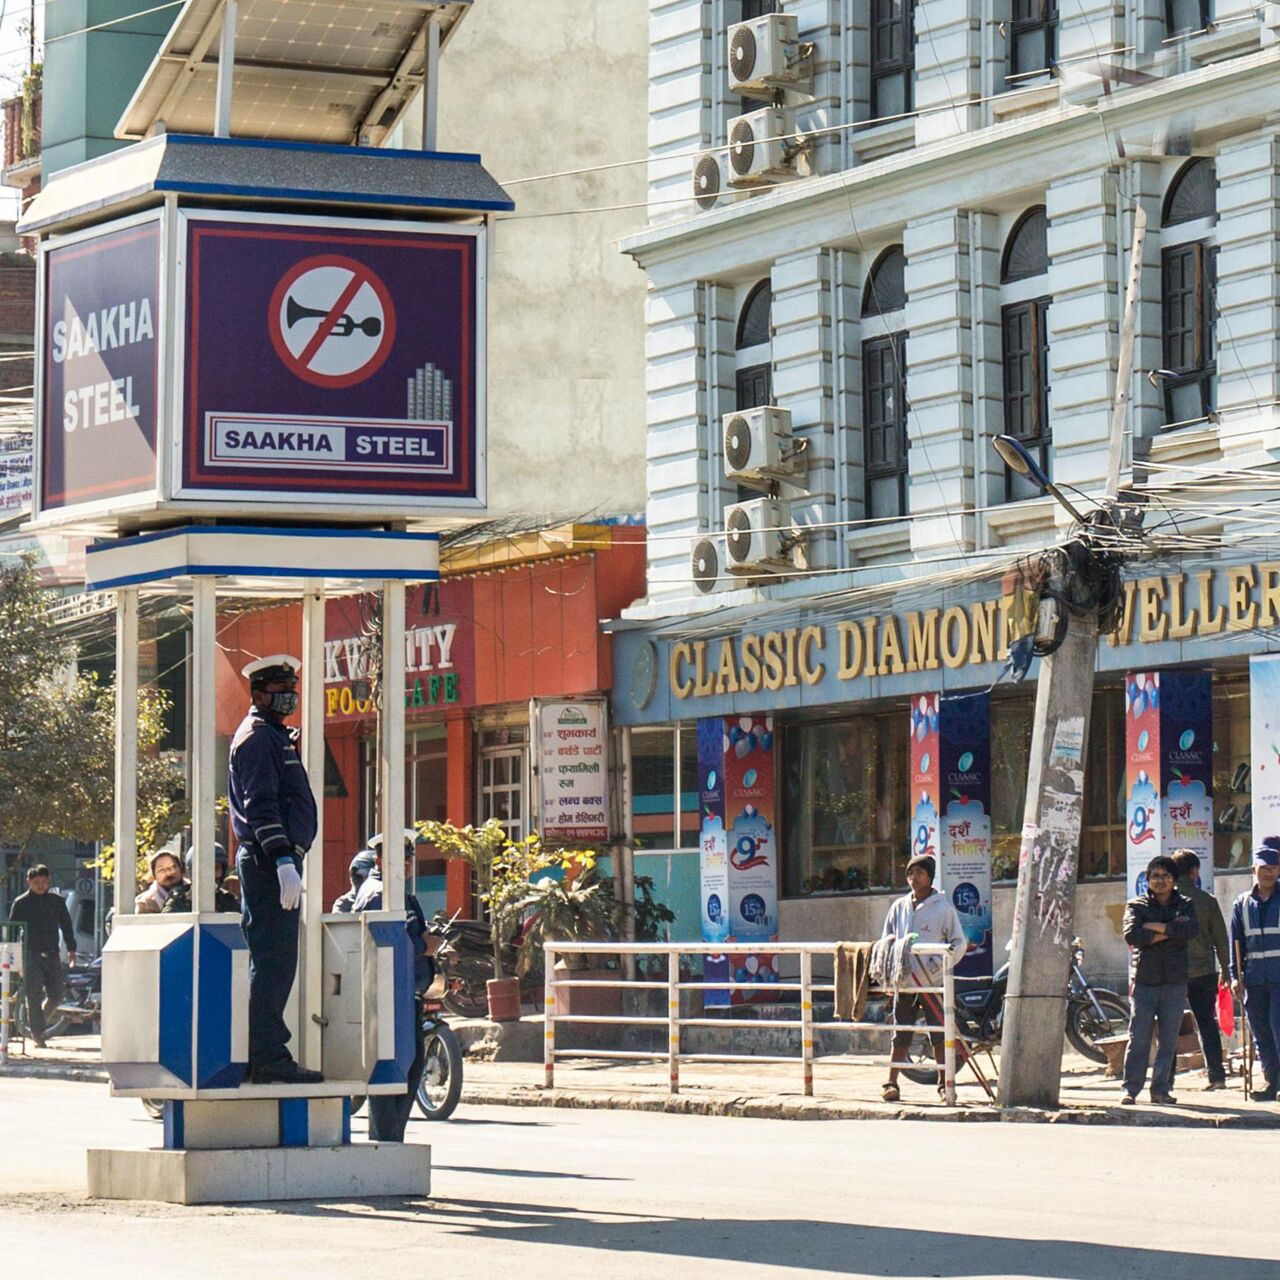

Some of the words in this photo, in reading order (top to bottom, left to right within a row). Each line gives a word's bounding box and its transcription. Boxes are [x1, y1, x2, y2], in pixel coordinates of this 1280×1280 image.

[52, 297, 154, 363] SAAKHA
[63, 375, 141, 433] STEEL
[224, 428, 333, 454] SAAKHA
[355, 434, 436, 458] STEEL
[324, 624, 457, 683] KWITY
[670, 625, 825, 700] CLASSIC
[404, 672, 458, 708] AFE
[1169, 751, 1202, 761] CLASSIC
[1170, 802, 1192, 820] दशैं
